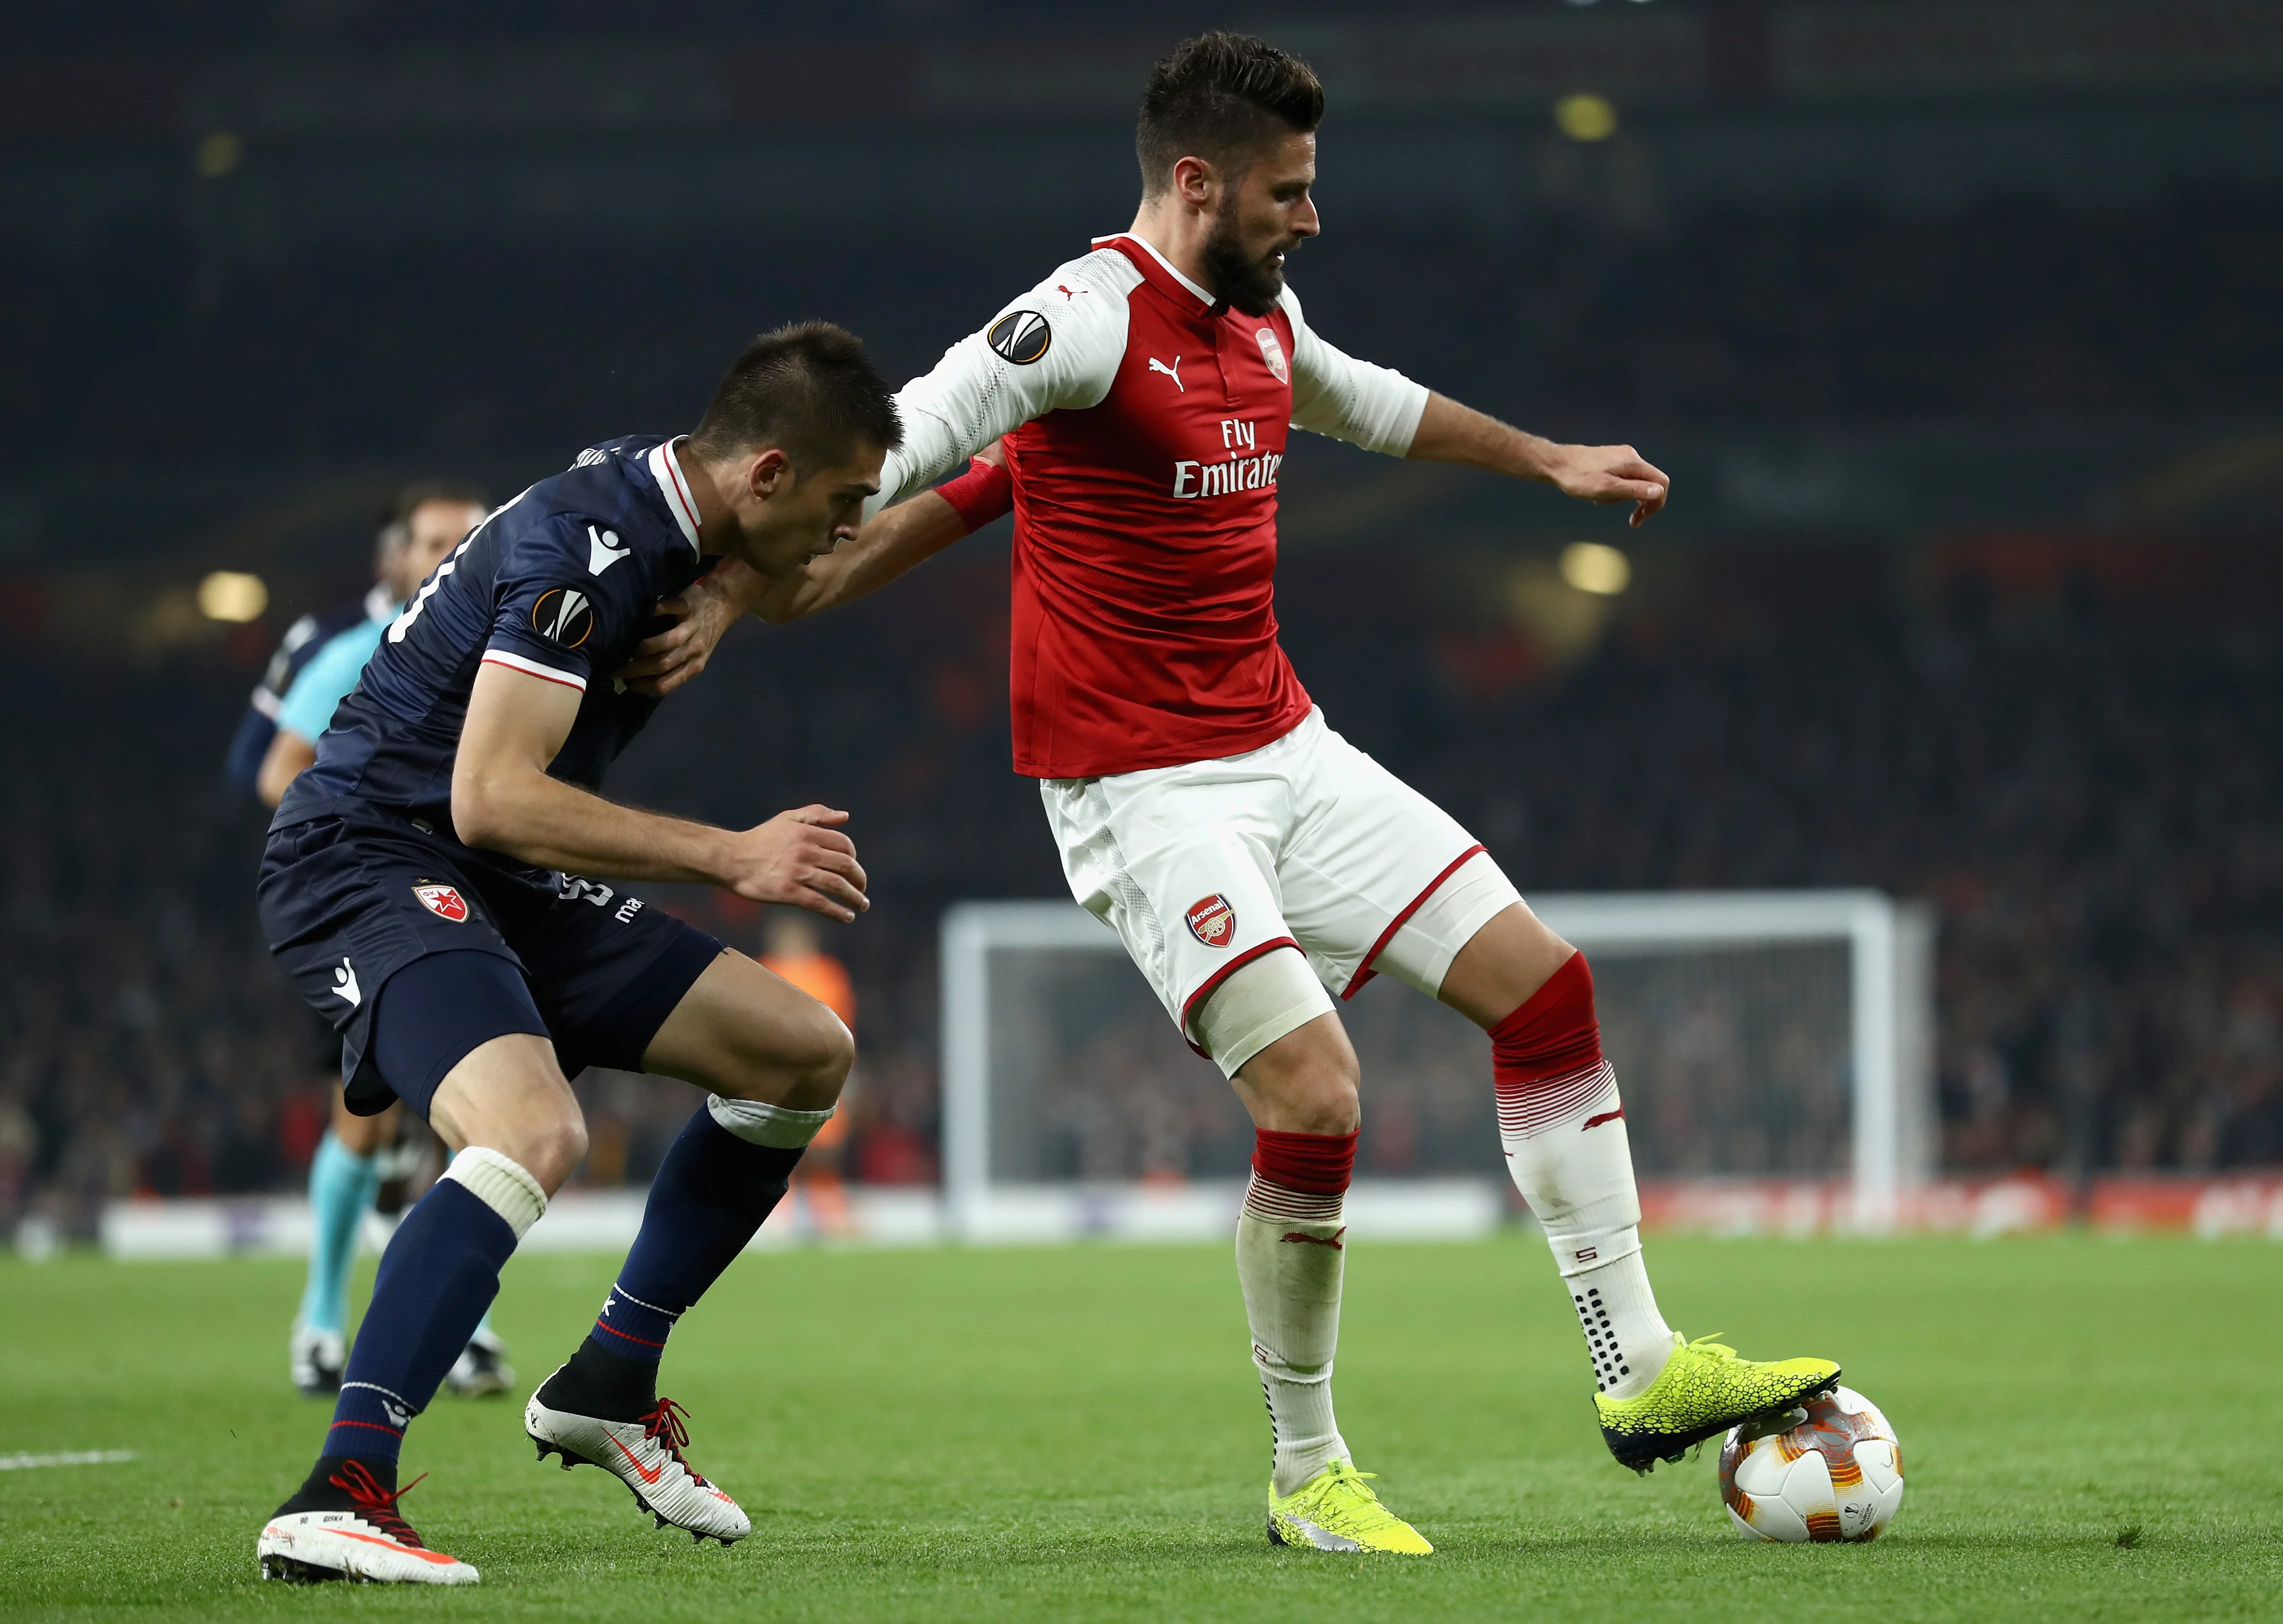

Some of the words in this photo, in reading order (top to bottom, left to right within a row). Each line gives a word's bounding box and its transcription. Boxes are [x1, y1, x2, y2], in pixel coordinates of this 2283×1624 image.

[1221, 419, 1255, 450] Fly
[1173, 450, 1283, 499] Emirate
[1191, 900, 1224, 925] Arsenal
